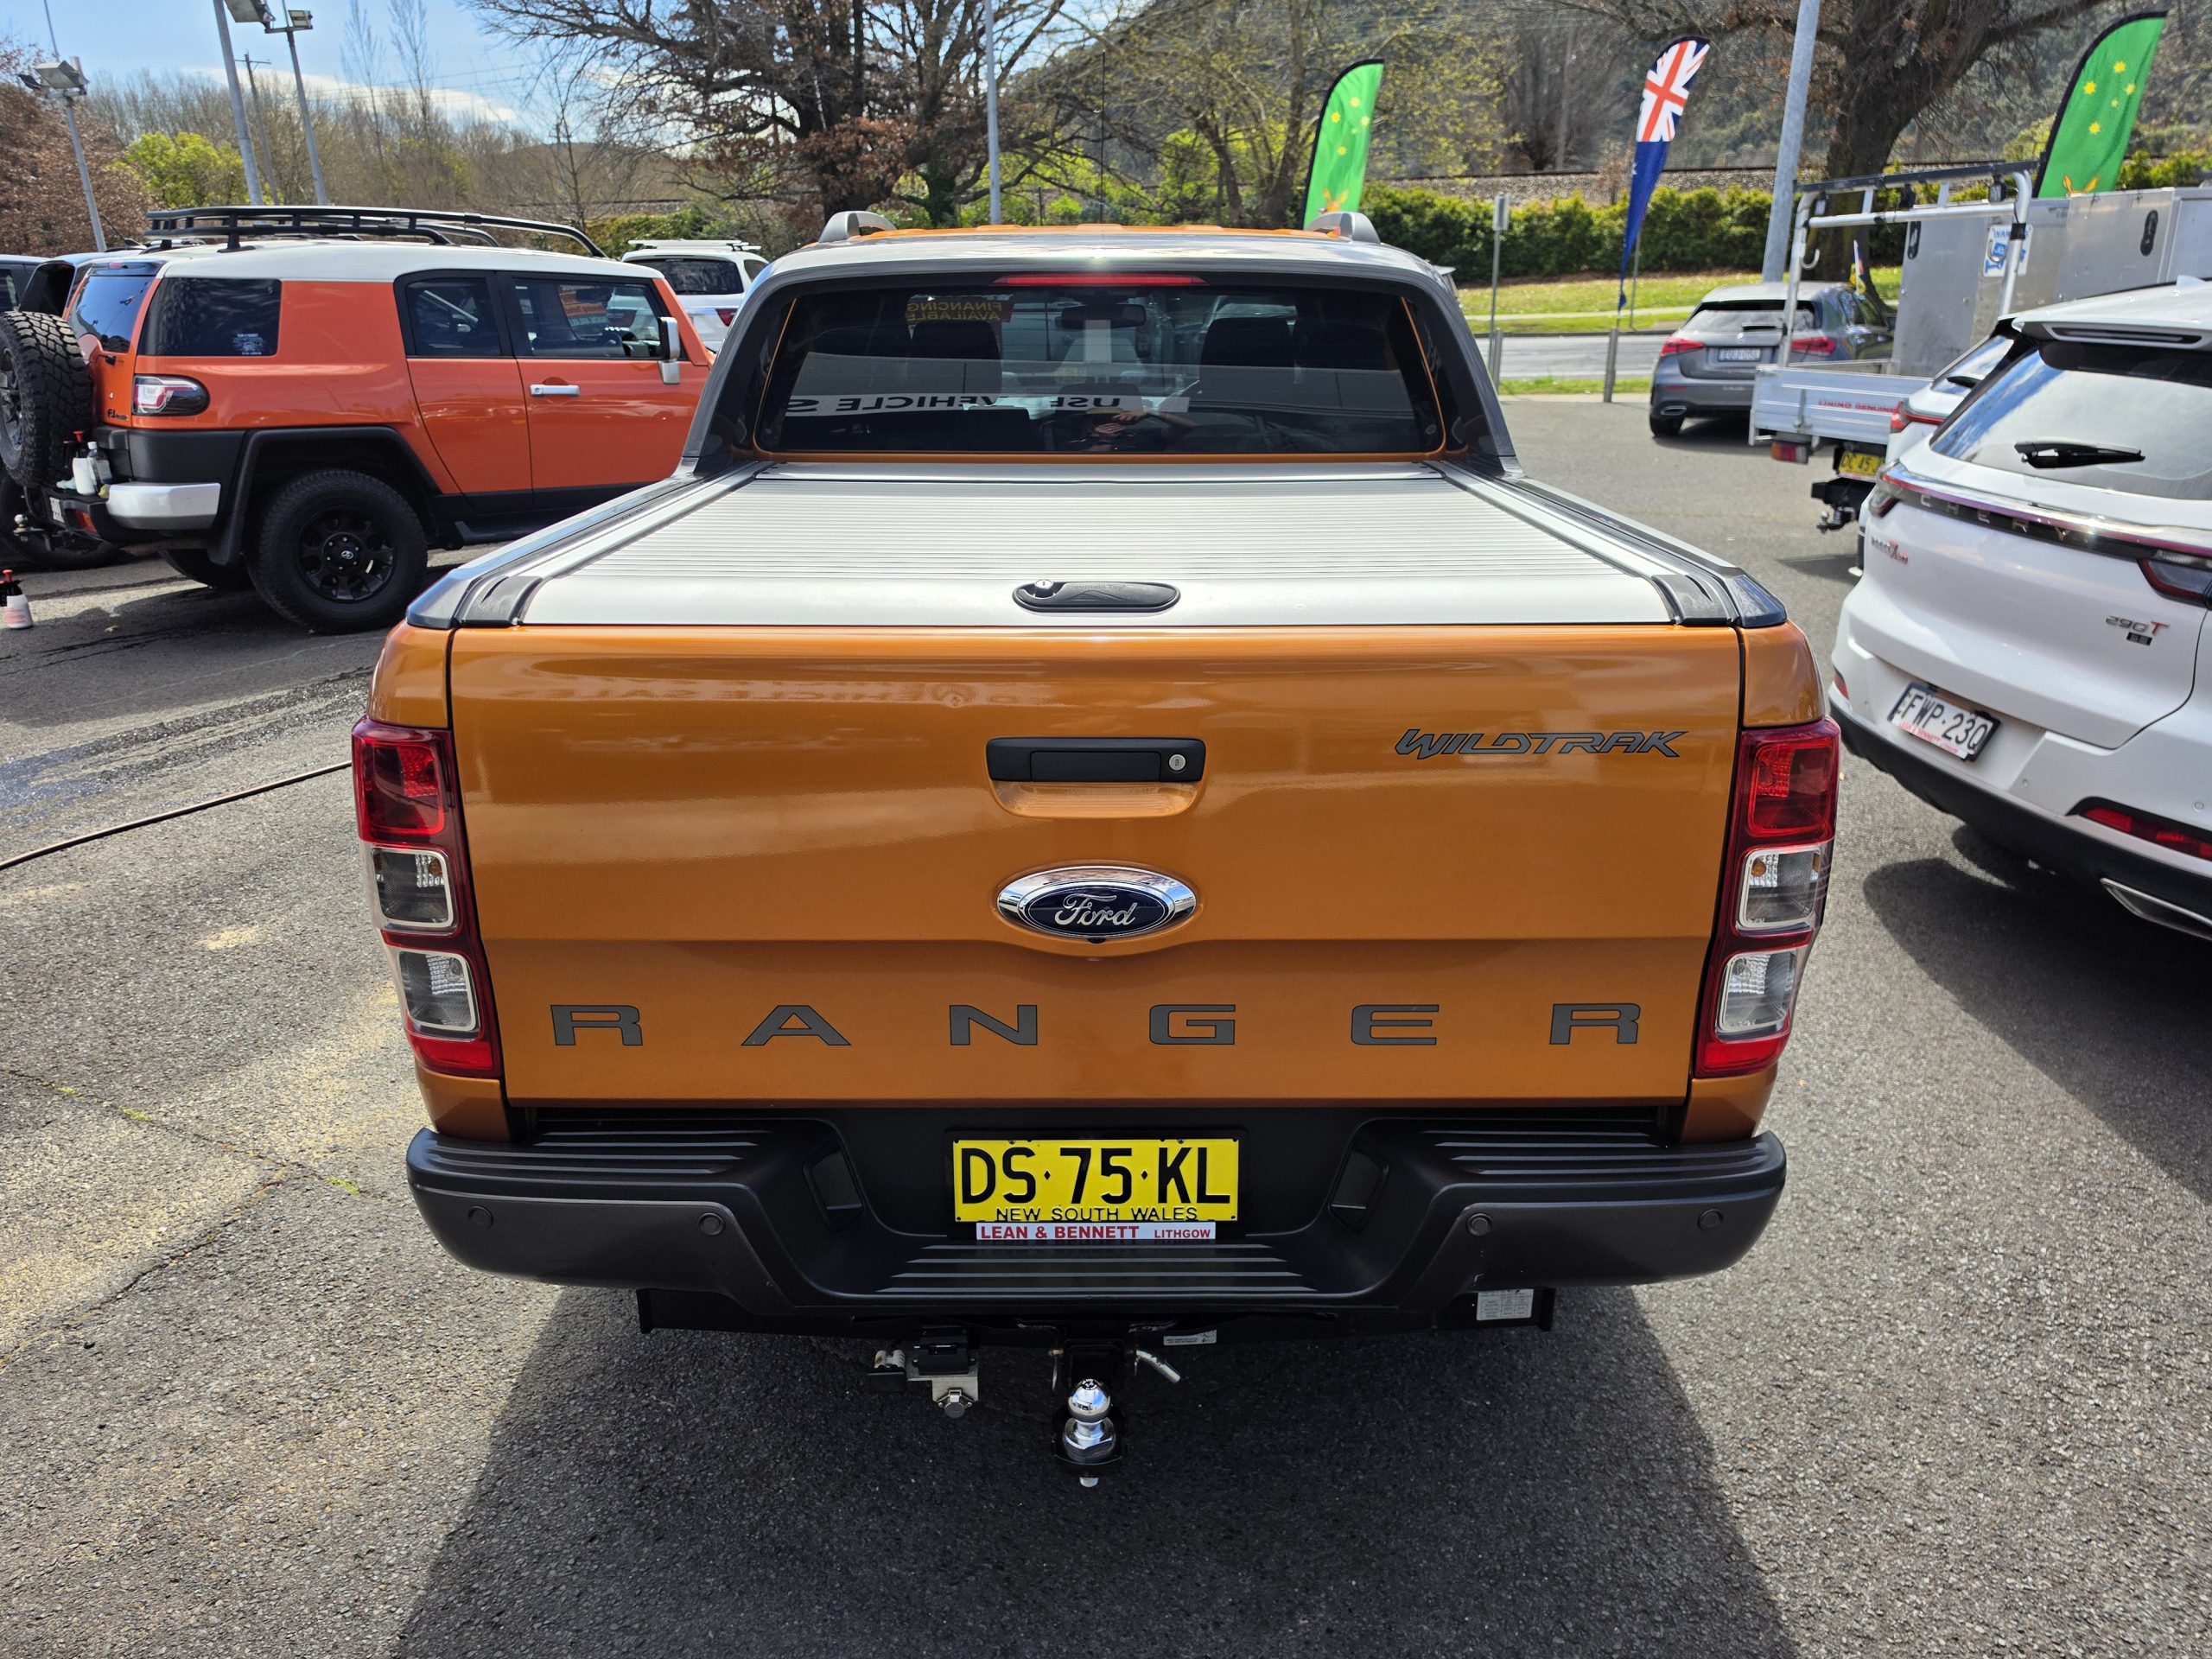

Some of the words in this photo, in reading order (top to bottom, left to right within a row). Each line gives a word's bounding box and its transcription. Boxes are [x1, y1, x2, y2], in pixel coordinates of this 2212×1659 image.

[1920, 494, 2072, 541] CHERY
[1395, 729, 1688, 760] WILDTRAK
[1055, 893, 1138, 926] Ford
[550, 1003, 1641, 1046] RANGER
[996, 1208, 1040, 1221] NEW
[1052, 1208, 1118, 1221] SOUTH
[1131, 1207, 1198, 1220] WALES
[981, 1226, 1027, 1238] LEAN
[1035, 1226, 1047, 1238] &
[1055, 1226, 1140, 1238] BENNETT
[1154, 1230, 1211, 1238] LITHGOW
